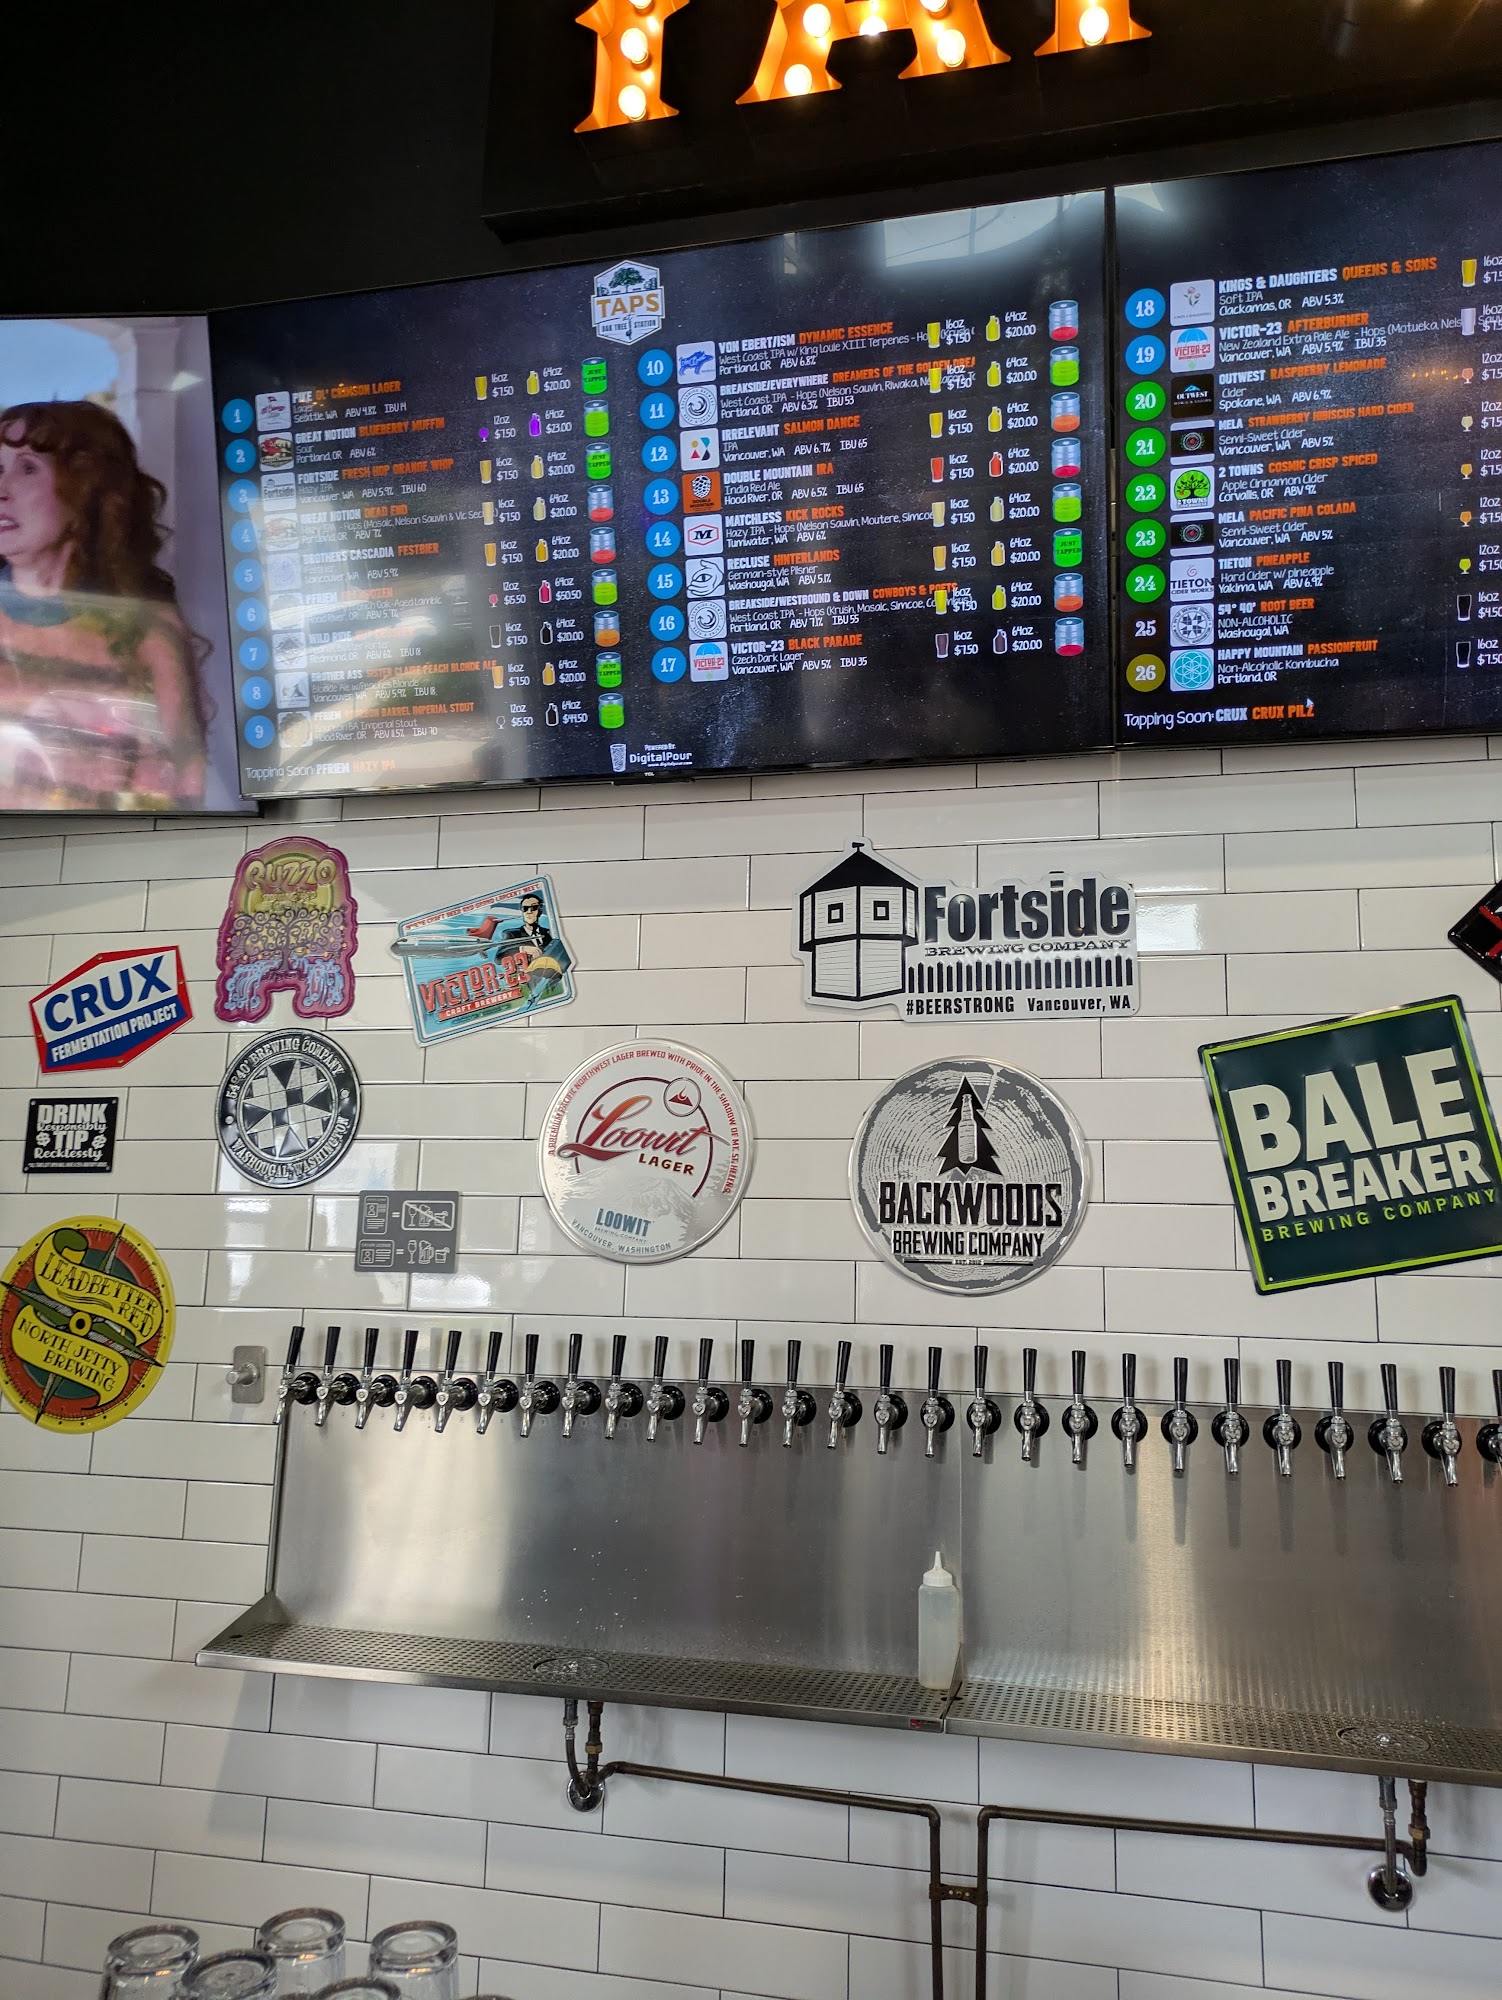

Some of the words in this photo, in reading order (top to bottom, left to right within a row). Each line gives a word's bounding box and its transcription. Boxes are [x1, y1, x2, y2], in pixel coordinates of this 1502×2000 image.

[1219, 278, 1252, 293] KINGS
[1256, 276, 1267, 289] &
[1269, 269, 1338, 288] DAUGHTERS
[1342, 262, 1388, 280] QUEENS
[1392, 261, 1401, 274] &
[1406, 257, 1437, 272] SONS
[597, 293, 659, 318] TAPS
[1219, 290, 1244, 305] Soft
[1246, 291, 1263, 302] IPA
[1279, 299, 1292, 310] OR
[1302, 296, 1323, 308] ABV
[1324, 293, 1344, 305] 5.3%
[1135, 300, 1155, 317] 18
[634, 319, 656, 329] STATION
[1005, 325, 1036, 338] $20.00
[1219, 321, 1282, 340] VICTOR-23
[1287, 313, 1369, 333] AFTERBURNER
[719, 339, 739, 353] VON
[742, 334, 795, 352] EBERT/ISM
[799, 327, 845, 345] DYNAMIC
[848, 322, 894, 339] ESSENCE
[762, 360, 771, 370] OR
[781, 357, 798, 369] ABV
[799, 355, 816, 366] 6.8%
[1135, 347, 1155, 364] 19
[646, 360, 664, 375] 10
[1219, 370, 1266, 384] OUTWEST
[1270, 362, 1329, 380] RASPBERRY
[1333, 358, 1387, 374] LEMONADE
[720, 374, 829, 396] BREAKSIDE/EVERYWHERE
[832, 365, 880, 383] DREAMERS
[649, 404, 665, 419] 11
[1134, 393, 1156, 410] 20
[234, 408, 242, 423] 1
[1219, 419, 1243, 430] MELA
[1248, 412, 1310, 427] STRAWBERRY
[1312, 408, 1355, 422] HIBISCUS
[1358, 405, 1384, 417] HARD
[1387, 402, 1414, 415] CIDER
[296, 430, 322, 444] GREAT
[324, 427, 356, 440] NOTION
[359, 422, 409, 437] BLUEBERRY
[412, 417, 445, 431] MUFFIN
[722, 424, 779, 441] IRRELEVANT
[784, 417, 824, 435] SALMON
[827, 415, 860, 430] DANCE
[236, 449, 245, 463] 2
[651, 446, 668, 462] 12
[1135, 439, 1155, 455] 21
[724, 468, 761, 485] DOUBLE
[763, 464, 813, 482] MOUNTAIN
[816, 462, 834, 476] IRA
[1219, 468, 1226, 477] 2
[1229, 463, 1263, 476] TOWNS
[1268, 460, 1306, 473] COSMIC
[1309, 458, 1338, 470] CRISP
[1342, 453, 1378, 467] SPICED
[298, 470, 339, 484] FORTSIDE
[239, 489, 248, 503] 3
[652, 489, 669, 504] 13
[1134, 484, 1156, 501] 22
[725, 512, 782, 528] MATCHLESS
[785, 508, 809, 522] KICK
[812, 505, 845, 520] ROCKS
[1219, 512, 1245, 524] MELA
[1249, 508, 1287, 522] PACIFIC
[1290, 506, 1313, 518] PINA
[1317, 502, 1356, 516] COLADA
[654, 531, 672, 547] 14
[1135, 530, 1155, 547] 23
[398, 543, 439, 556] FESTBIER
[727, 556, 770, 570] RECLUSE
[774, 550, 840, 567] HINTERLANDS
[1219, 556, 1252, 569] TIETON
[1256, 552, 1310, 567] PINEAPPLE
[657, 573, 674, 589] 15
[1134, 576, 1156, 592] 24
[729, 593, 830, 611] BREAKSIDE/WESTBOUND
[833, 591, 840, 601] &
[843, 590, 868, 601] DOWN
[873, 586, 916, 600] COWBOYS
[1260, 600, 1286, 613] ROOT
[1289, 598, 1314, 610] BEER
[659, 616, 675, 631] 16
[1135, 620, 1156, 637] 25
[731, 640, 784, 655] VICTOR-23
[788, 637, 820, 651] BLACK
[823, 633, 862, 647] PARADE
[1218, 646, 1251, 660] HAPPY
[1254, 644, 1303, 658] MOUNTAIN
[1308, 640, 1378, 655] PASSIONFRUIT
[660, 658, 676, 673] 17
[1135, 665, 1156, 681] 26
[1124, 712, 1174, 729] Tapping
[1216, 708, 1247, 722] CRUX
[1252, 705, 1284, 720] CRUX
[630, 751, 692, 765] DigitalPour
[925, 871, 1131, 943] Fortside
[925, 944, 1025, 957] BREWING
[1029, 939, 1131, 953] COMPANY
[420, 952, 531, 1013] VICTOR-23
[45, 955, 173, 1032] CRUX
[446, 1004, 471, 1017] CRAFT
[475, 992, 513, 1008] BREWERY
[906, 996, 1015, 1015] #BEERSTRONG
[1027, 997, 1106, 1012] Vancouver,
[1110, 995, 1130, 1009] WA
[51, 1020, 128, 1063] FERMENTATION
[131, 1003, 177, 1034] PROJECT
[250, 1039, 300, 1066] BREWING
[302, 1037, 345, 1076] COMPANY
[559, 1088, 577, 1114] PACIFIC
[575, 1060, 611, 1090] NORTHWEST
[612, 1050, 634, 1063] LAGER
[636, 1050, 666, 1058] BREWED
[668, 1052, 685, 1064] WITH
[685, 1060, 705, 1077] PRIDE
[703, 1073, 713, 1083] IN
[710, 1080, 721, 1094] THE
[718, 1093, 737, 1126] SHADOW
[38, 1104, 108, 1124] DRINK
[1228, 1048, 1475, 1172] BALE
[37, 1121, 107, 1133] Responsibly
[557, 1095, 731, 1161] Loowit
[53, 1131, 89, 1150] TIP
[230, 1139, 293, 1178] WASHOUGAL,
[294, 1116, 350, 1176] WASHINGTON
[34, 1148, 102, 1161] Recklessly
[639, 1153, 695, 1175] LAGER
[1250, 1139, 1491, 1223] BREAKER
[879, 1182, 1062, 1226] BACKWOODS
[595, 1208, 650, 1236] LOOWIT
[1262, 1211, 1370, 1242] BREWING
[1383, 1188, 1496, 1220] COMPANY
[618, 1242, 671, 1254] WASHINGTON
[892, 1231, 964, 1255] BREWING
[968, 1232, 1044, 1257] COMPANY
[39, 1253, 159, 1315] LEADBETTER
[118, 1302, 154, 1338] RED
[17, 1318, 70, 1352] NORTH
[73, 1343, 122, 1378] JETTY
[43, 1350, 115, 1392] BREWING
